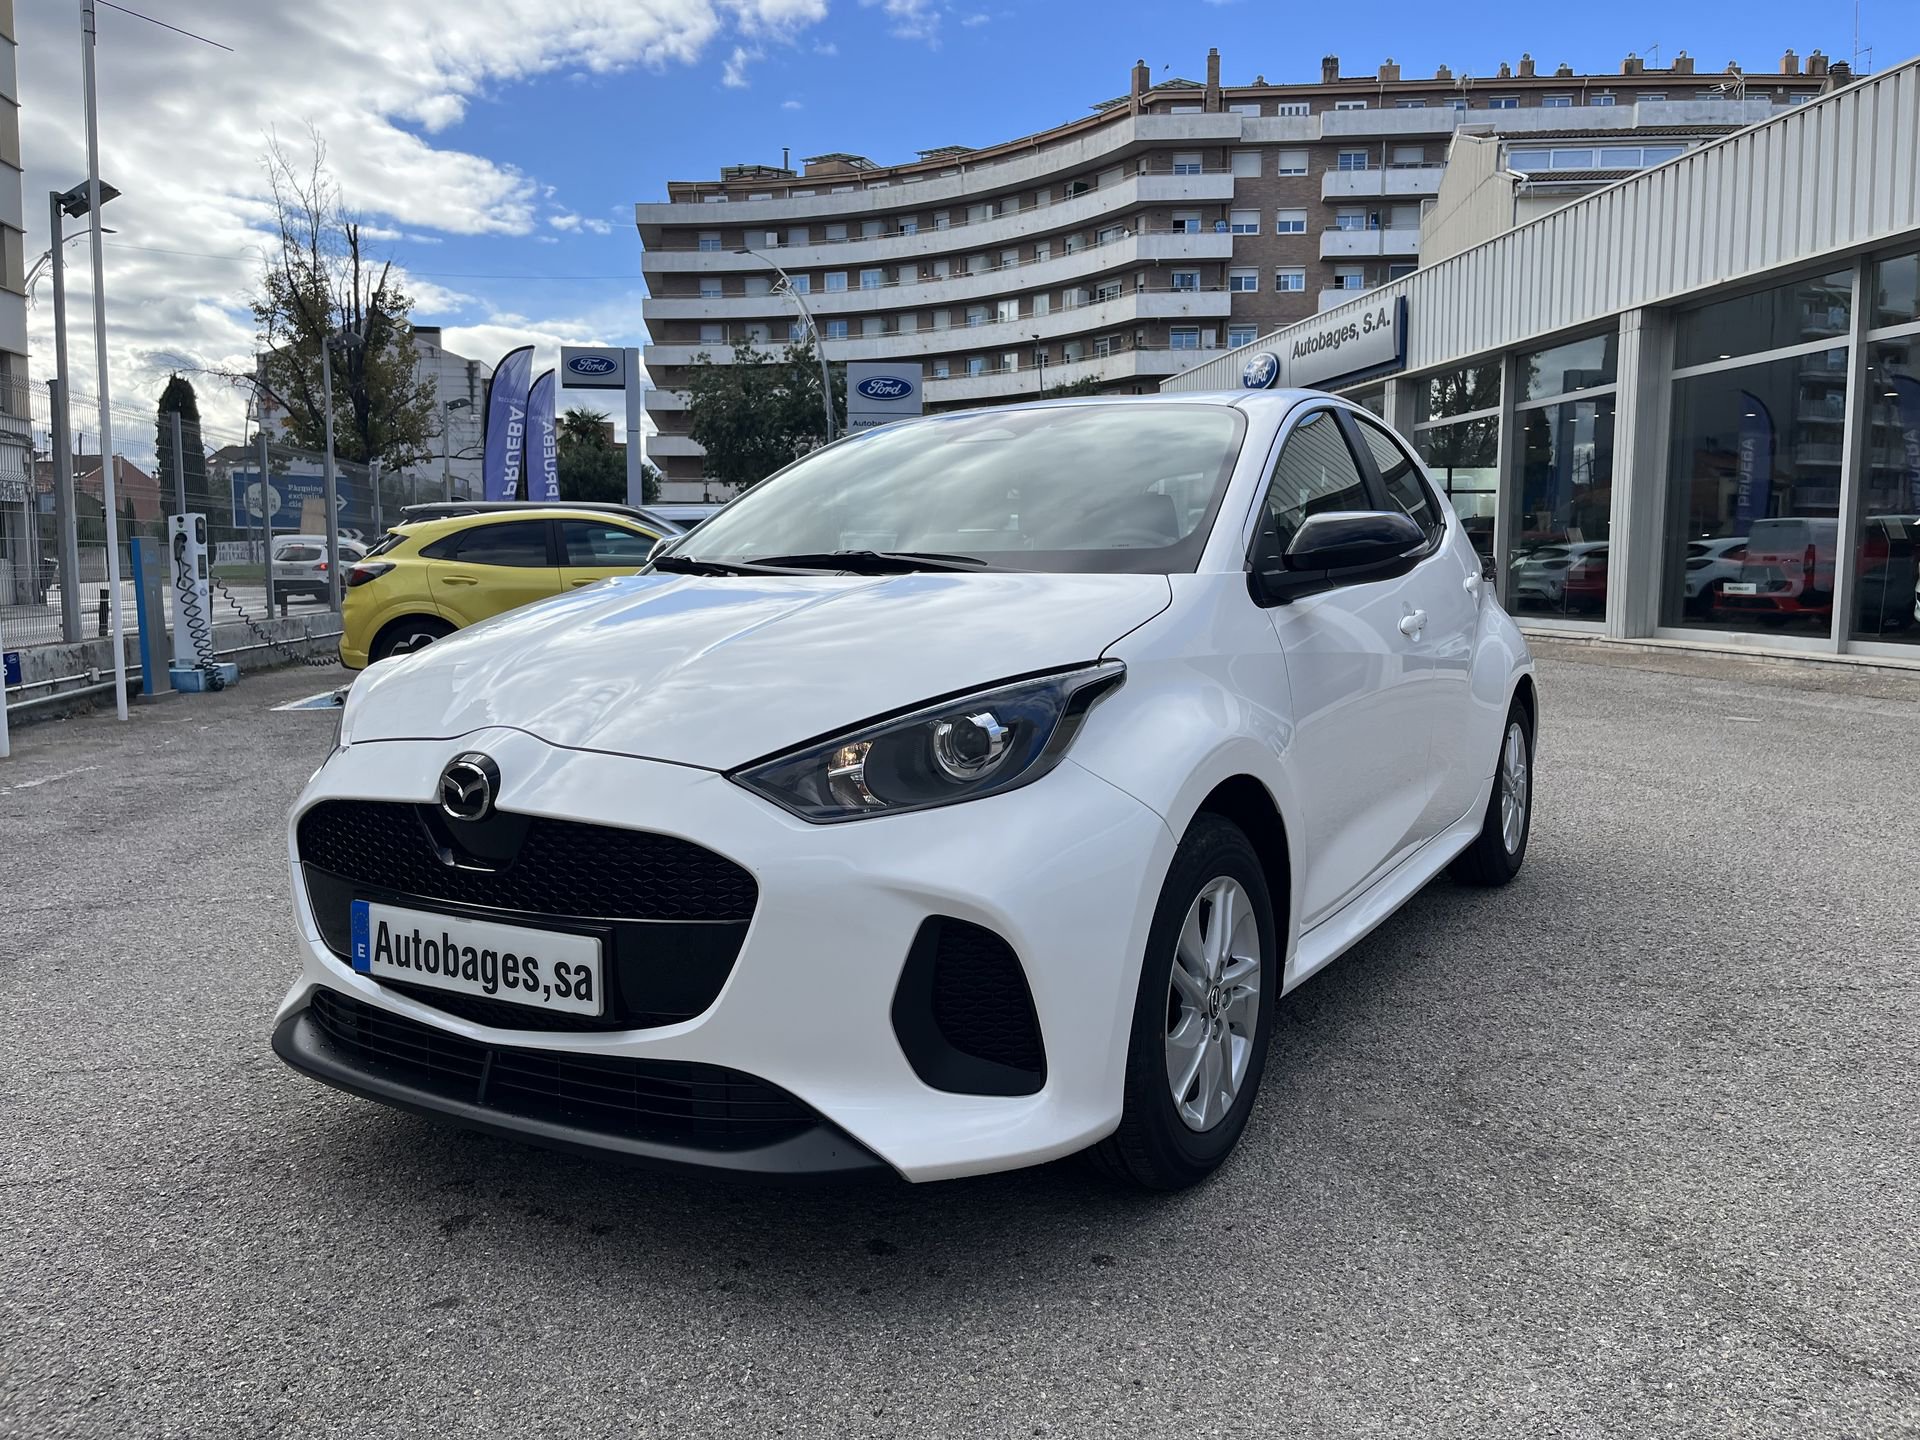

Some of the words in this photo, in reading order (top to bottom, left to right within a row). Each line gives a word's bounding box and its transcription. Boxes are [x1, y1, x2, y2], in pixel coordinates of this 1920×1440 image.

[1292, 322, 1359, 360] Autobages,
[1363, 307, 1391, 334] S.A.
[577, 358, 608, 372] Ford
[867, 379, 902, 395] Ford
[1737, 437, 1756, 508] PRUEBA
[357, 943, 366, 958] E
[374, 920, 593, 1002] Autobages,sa
